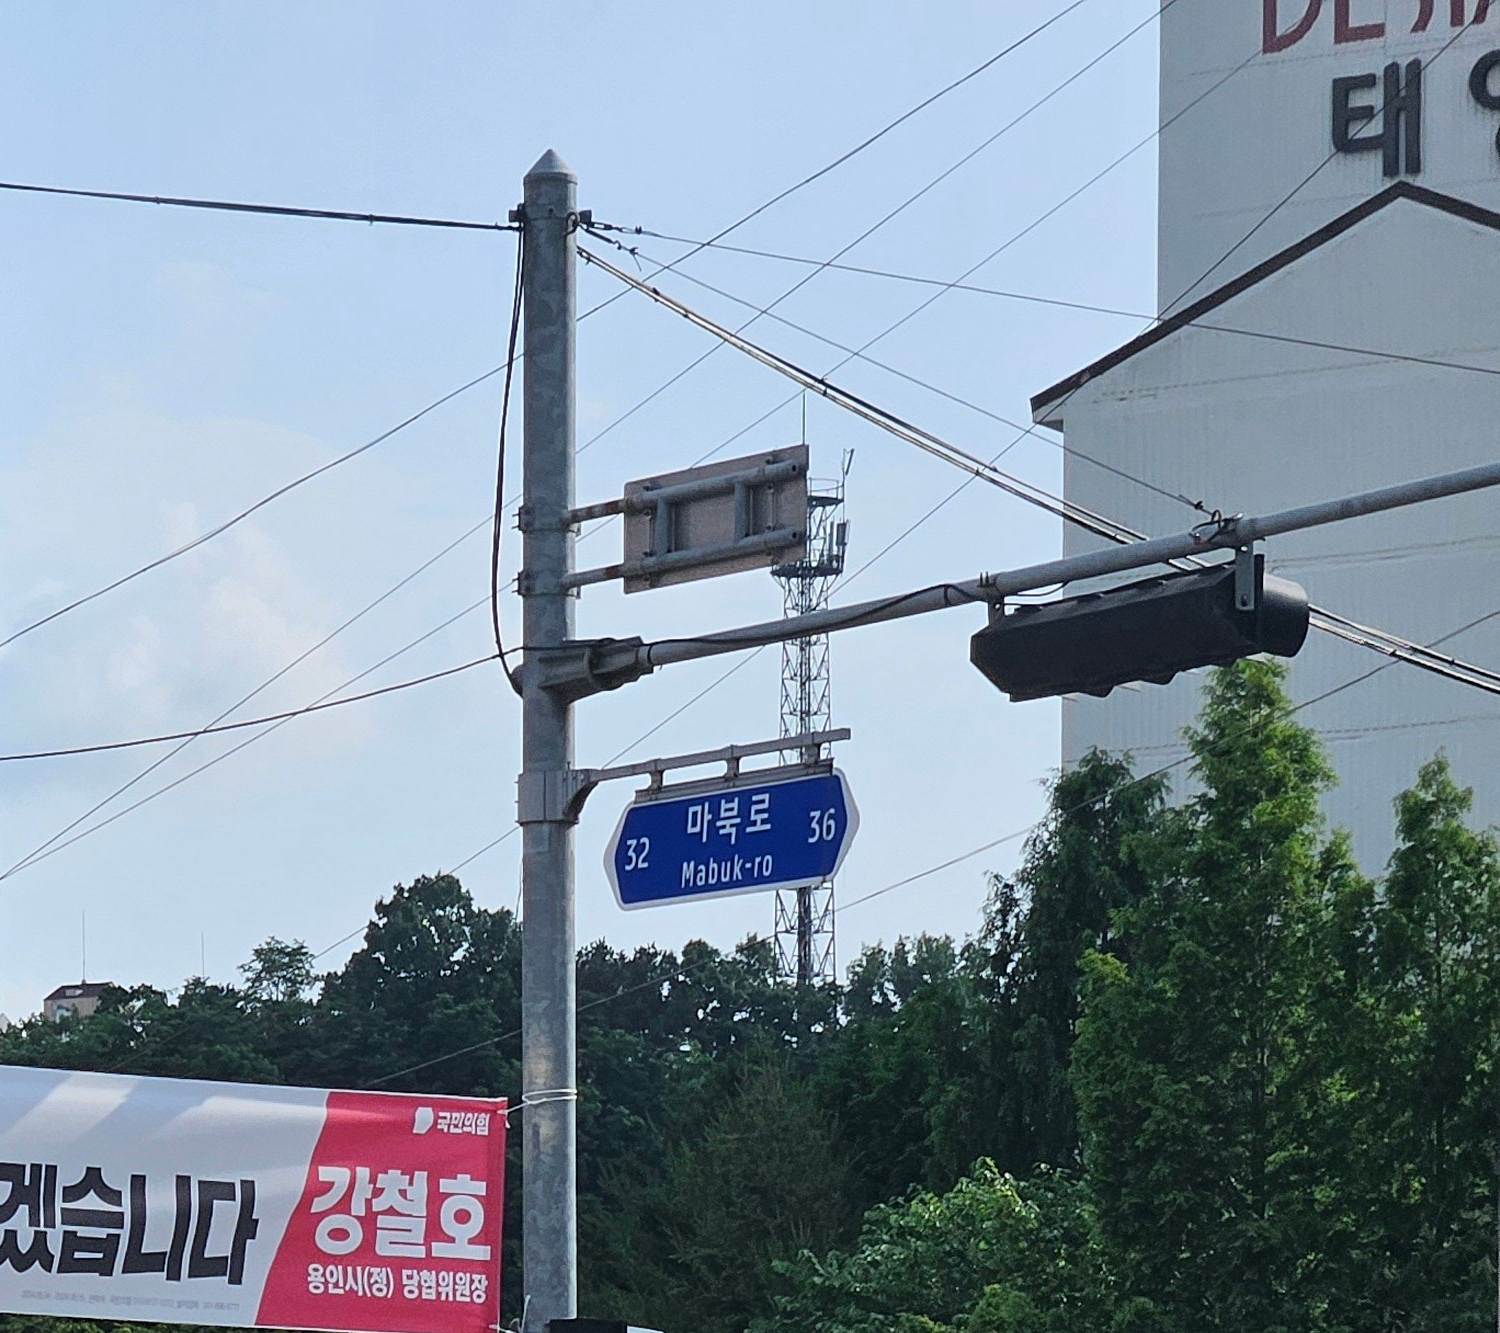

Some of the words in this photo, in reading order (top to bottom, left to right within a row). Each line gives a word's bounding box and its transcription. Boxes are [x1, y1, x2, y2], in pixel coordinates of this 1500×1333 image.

[687, 793, 772, 845] 마북로
[808, 808, 836, 844] 36
[625, 837, 651, 871] 32
[681, 854, 773, 889] Mabuk-ro
[437, 1112, 490, 1135] 국민의힘
[310, 1166, 491, 1260] 강철호
[307, 1263, 394, 1298] 용인시(정)
[402, 1269, 488, 1303] 당협위원장
